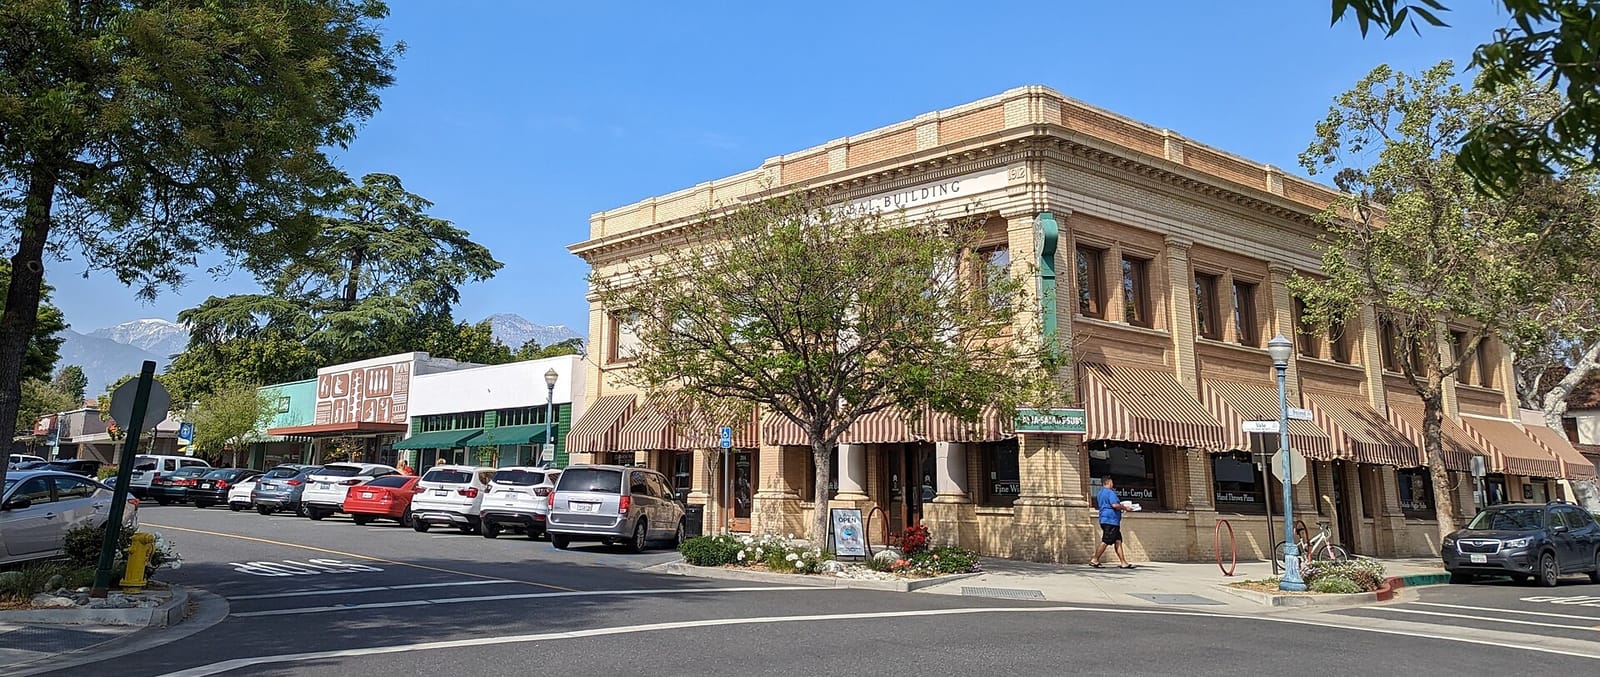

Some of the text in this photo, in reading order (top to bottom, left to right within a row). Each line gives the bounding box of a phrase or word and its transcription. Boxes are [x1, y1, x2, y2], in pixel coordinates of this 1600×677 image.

[1007, 167, 1026, 181] 1912
[884, 180, 961, 208] BUILDING
[994, 484, 1020, 494] Fine Wi
[1130, 489, 1144, 498] Carry
[1143, 489, 1153, 498] Out
